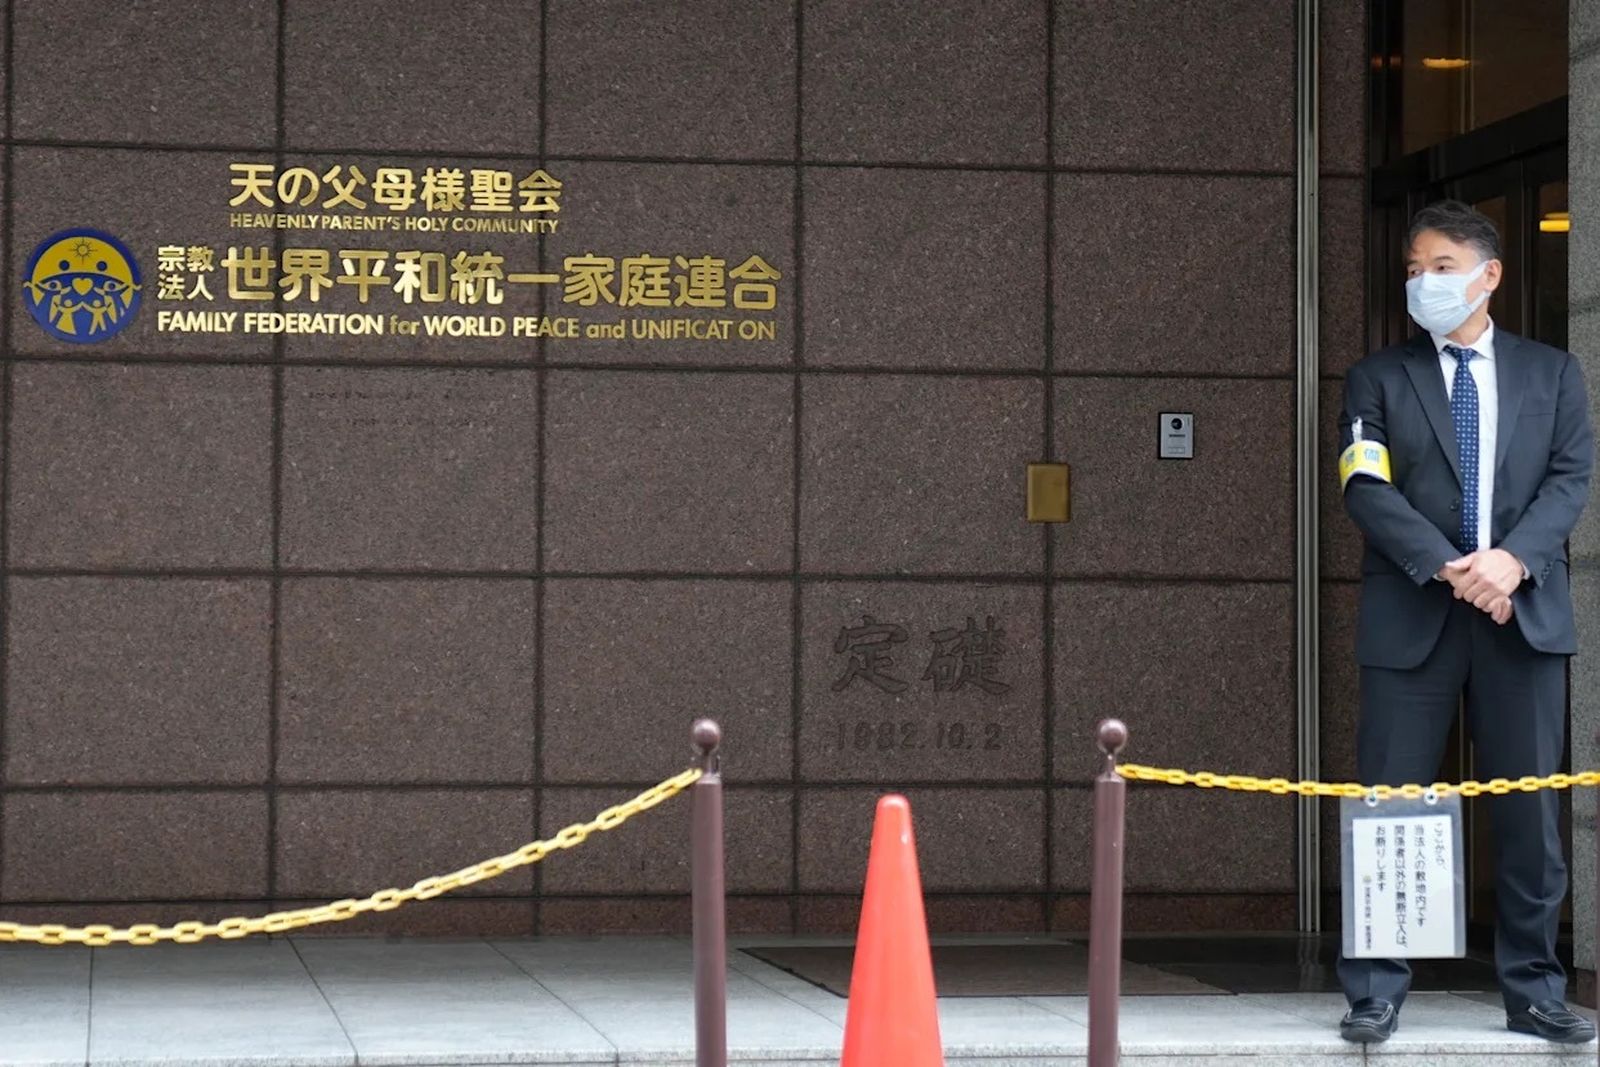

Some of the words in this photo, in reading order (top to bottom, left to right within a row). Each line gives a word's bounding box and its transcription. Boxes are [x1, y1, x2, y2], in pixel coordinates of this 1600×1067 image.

[229, 163, 563, 213] 天の父母様聖会
[229, 212, 319, 230] HEAVENLY
[321, 214, 401, 232] PARENT'S
[405, 216, 448, 232] HOLY
[452, 217, 560, 235] COMMUNITY
[157, 245, 214, 273] 宗教
[157, 273, 214, 302] 法人
[221, 246, 782, 310] 世界平和統一家庭連合
[157, 310, 238, 333] FAMILY
[244, 312, 385, 336] FEDERATION
[389, 313, 419, 336] for
[422, 315, 507, 339] WORLD
[512, 316, 580, 339] PEACE
[586, 319, 626, 341] and
[831, 614, 1012, 697] 定礎
